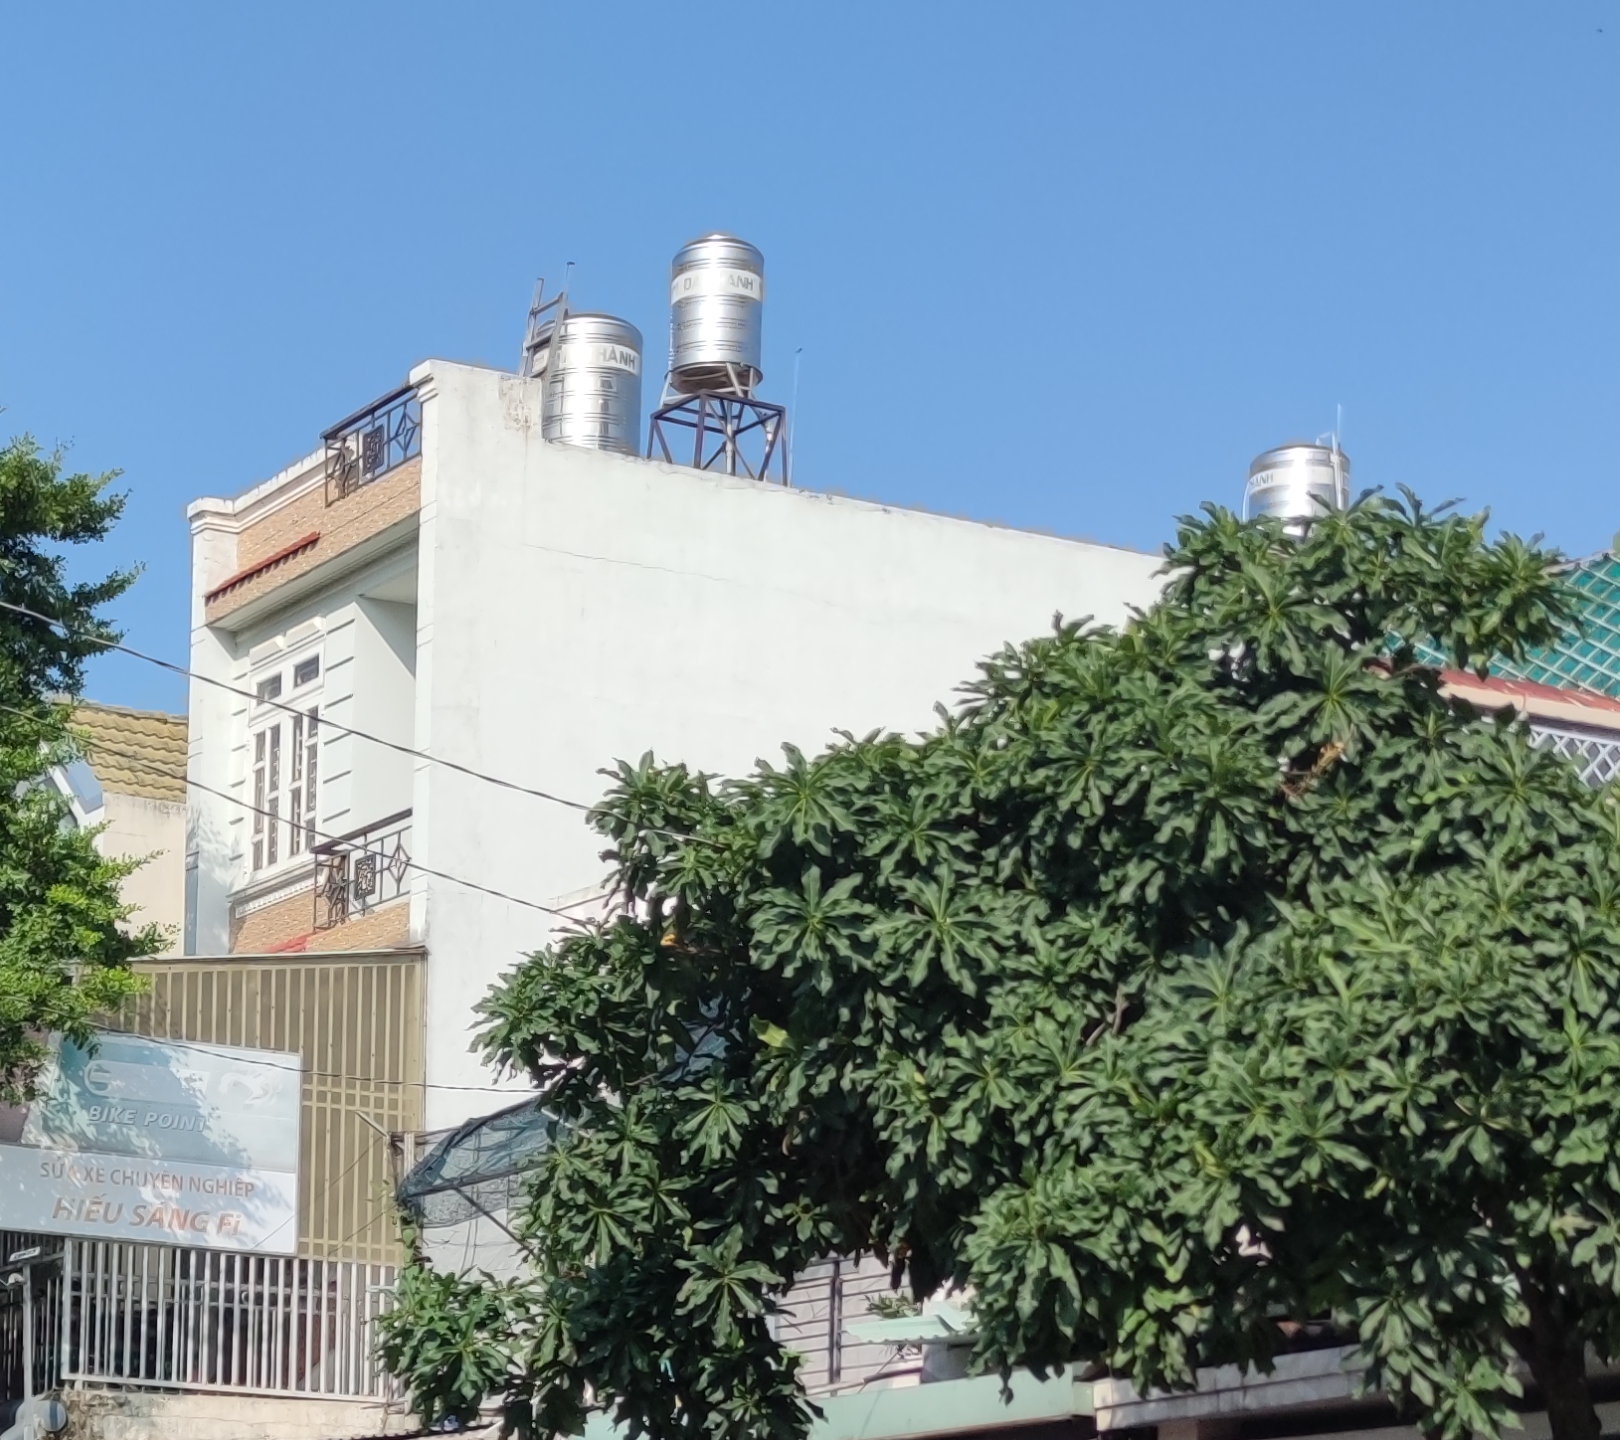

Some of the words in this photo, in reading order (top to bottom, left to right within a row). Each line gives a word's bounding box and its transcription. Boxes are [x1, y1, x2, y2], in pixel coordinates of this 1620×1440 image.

[88, 1105, 138, 1127] BIKE
[143, 1112, 208, 1133] POINT
[83, 1164, 106, 1184] XE
